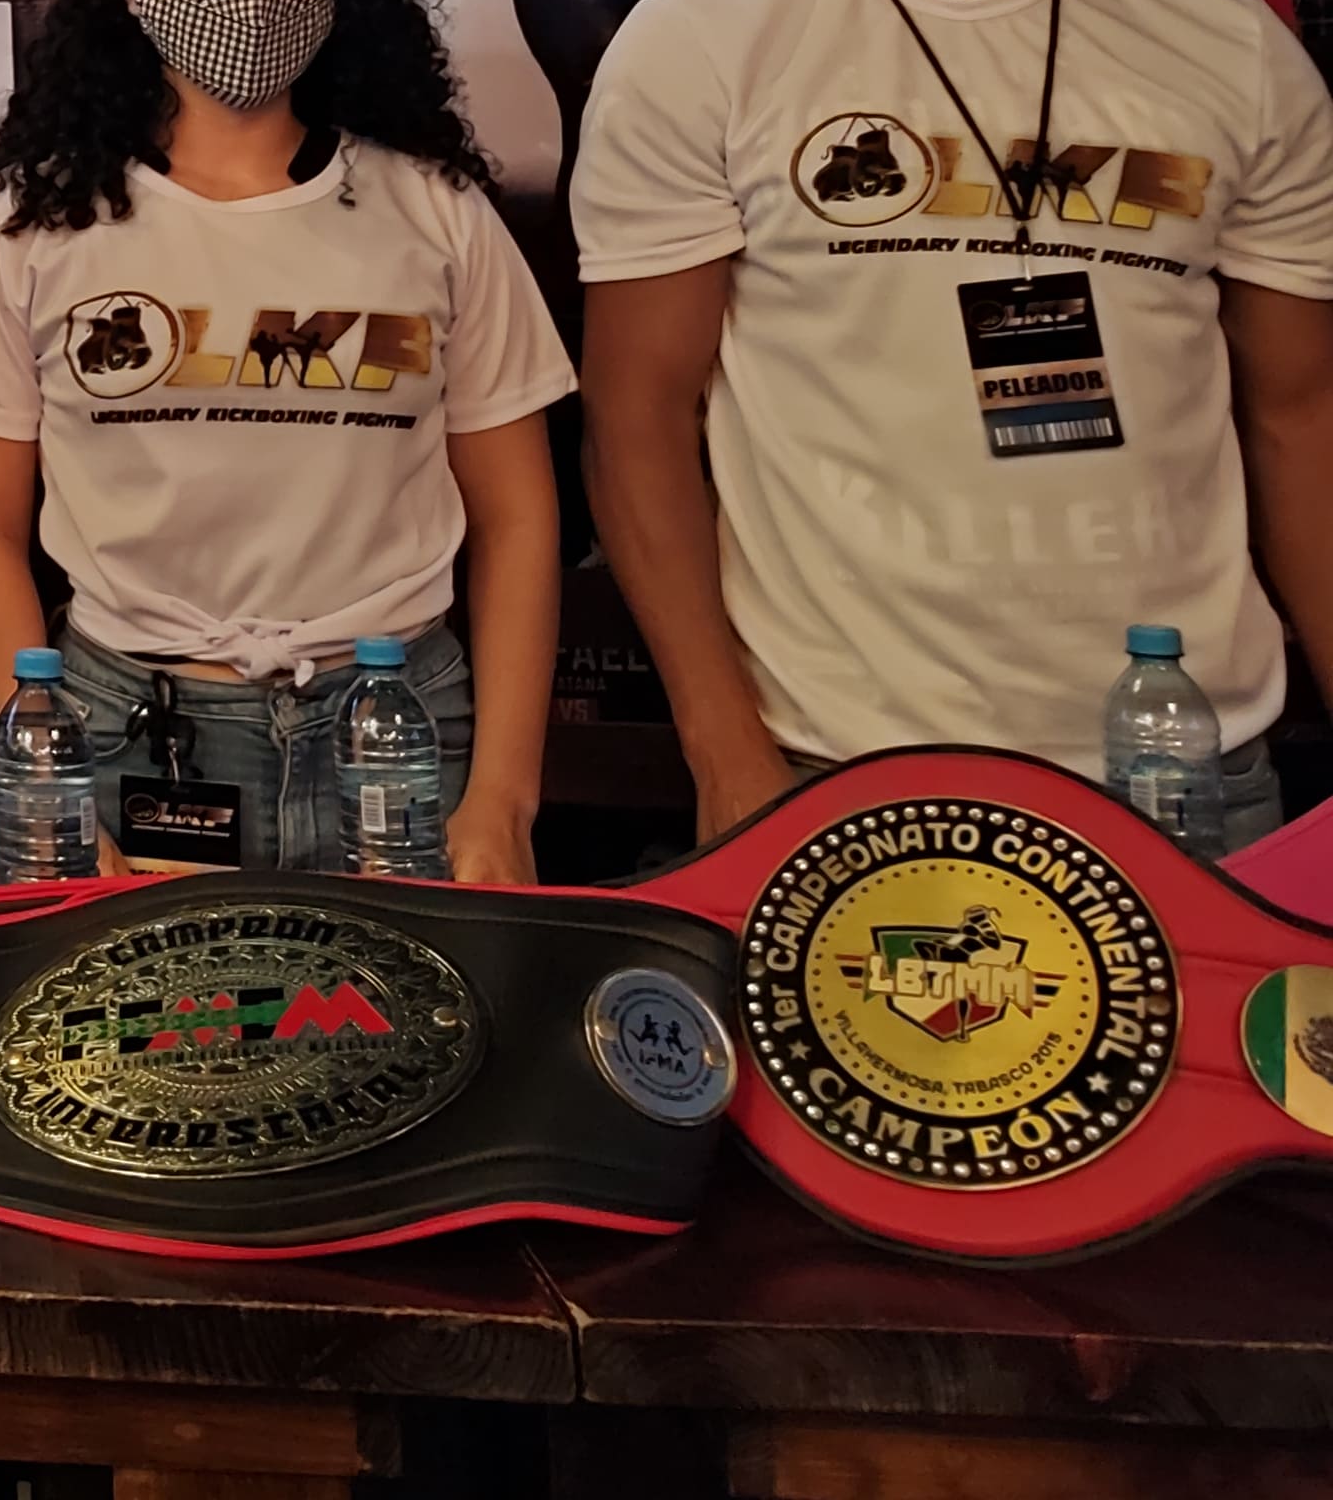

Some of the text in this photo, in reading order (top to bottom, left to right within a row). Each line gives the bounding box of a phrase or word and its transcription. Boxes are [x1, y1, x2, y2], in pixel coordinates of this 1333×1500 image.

[828, 237, 961, 257] LEGENDARY
[983, 369, 1105, 400] PELEADOR
[91, 408, 201, 425] LEGENDARY
[206, 408, 337, 426] KICKBOXING
[766, 822, 1146, 1061] 1er CAMPEONATO CONTINENTAL
[954, 1061, 1034, 1097] TABASCO
[1030, 1031, 1063, 1067] 2015
[808, 1067, 1093, 1160] CAMPEÓN
